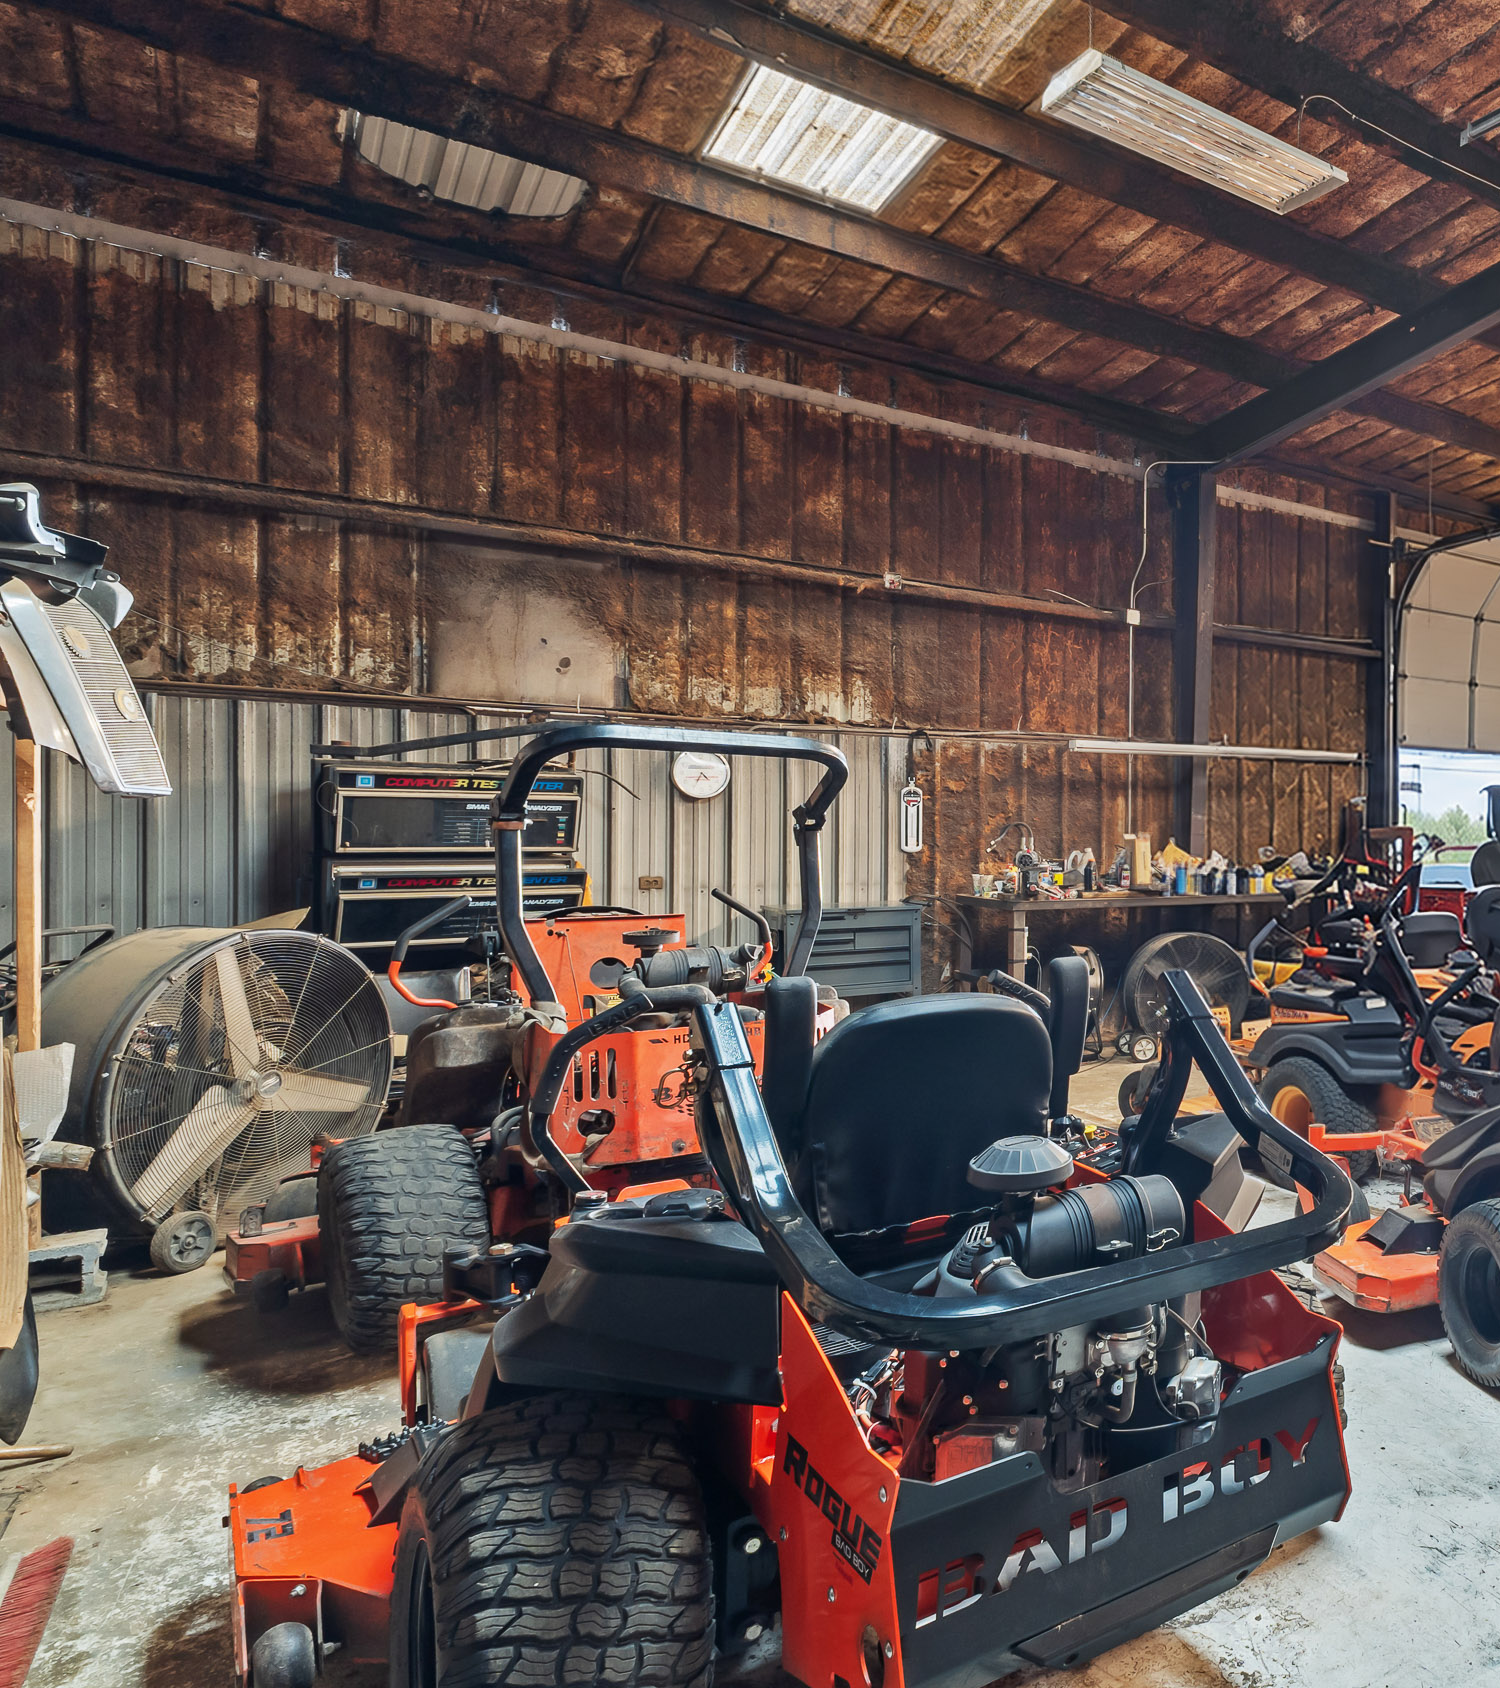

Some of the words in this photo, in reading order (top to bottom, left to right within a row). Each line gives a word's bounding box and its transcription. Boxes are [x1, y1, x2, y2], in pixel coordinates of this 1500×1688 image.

[385, 778, 469, 787] COMPUTER
[387, 878, 472, 887] COMPUTER
[521, 876, 567, 884] ENTER
[783, 1431, 883, 1571] ROGUE
[915, 1496, 1129, 1630] BAD
[1162, 1416, 1322, 1524] BOY
[835, 1534, 852, 1559] BAD
[852, 1553, 870, 1578] BOY
